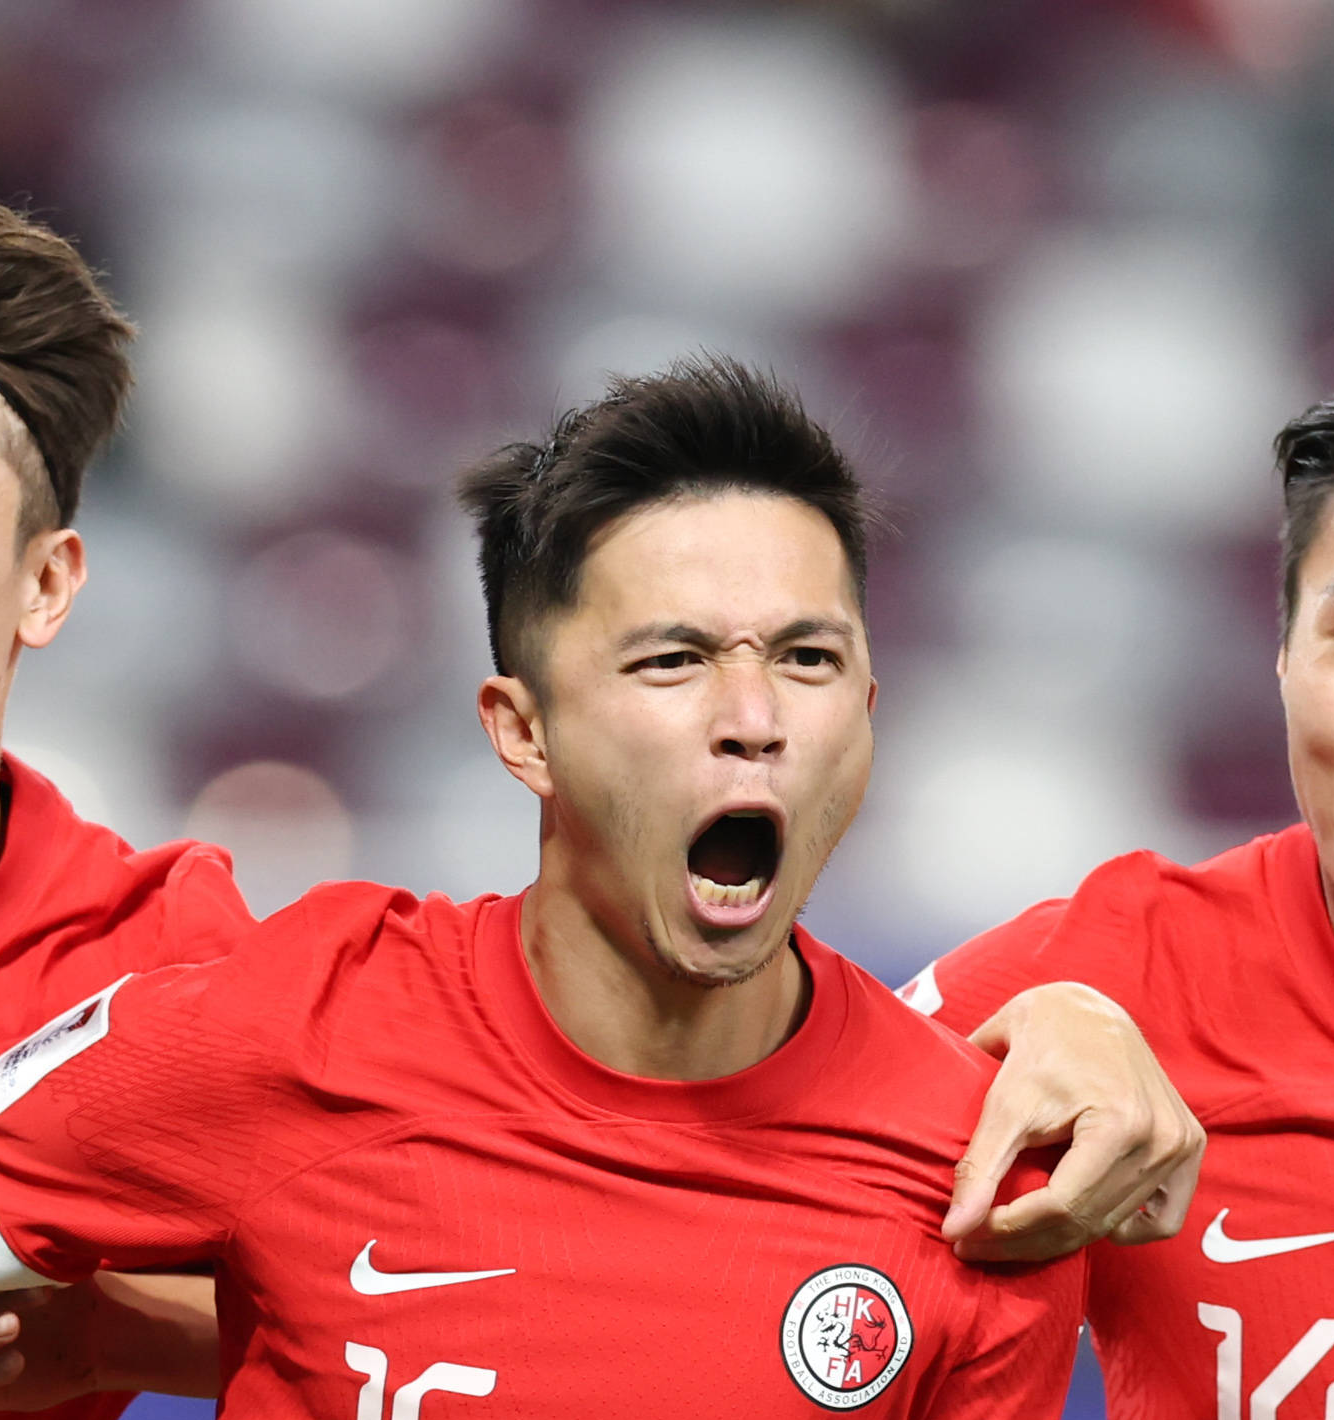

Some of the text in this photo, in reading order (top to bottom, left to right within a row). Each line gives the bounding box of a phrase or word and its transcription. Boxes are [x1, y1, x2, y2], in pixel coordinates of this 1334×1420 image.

[807, 1270, 897, 1305] THE HONG KONG
[786, 1320, 908, 1405] FOOTBALL ASSOCIATION LTD
